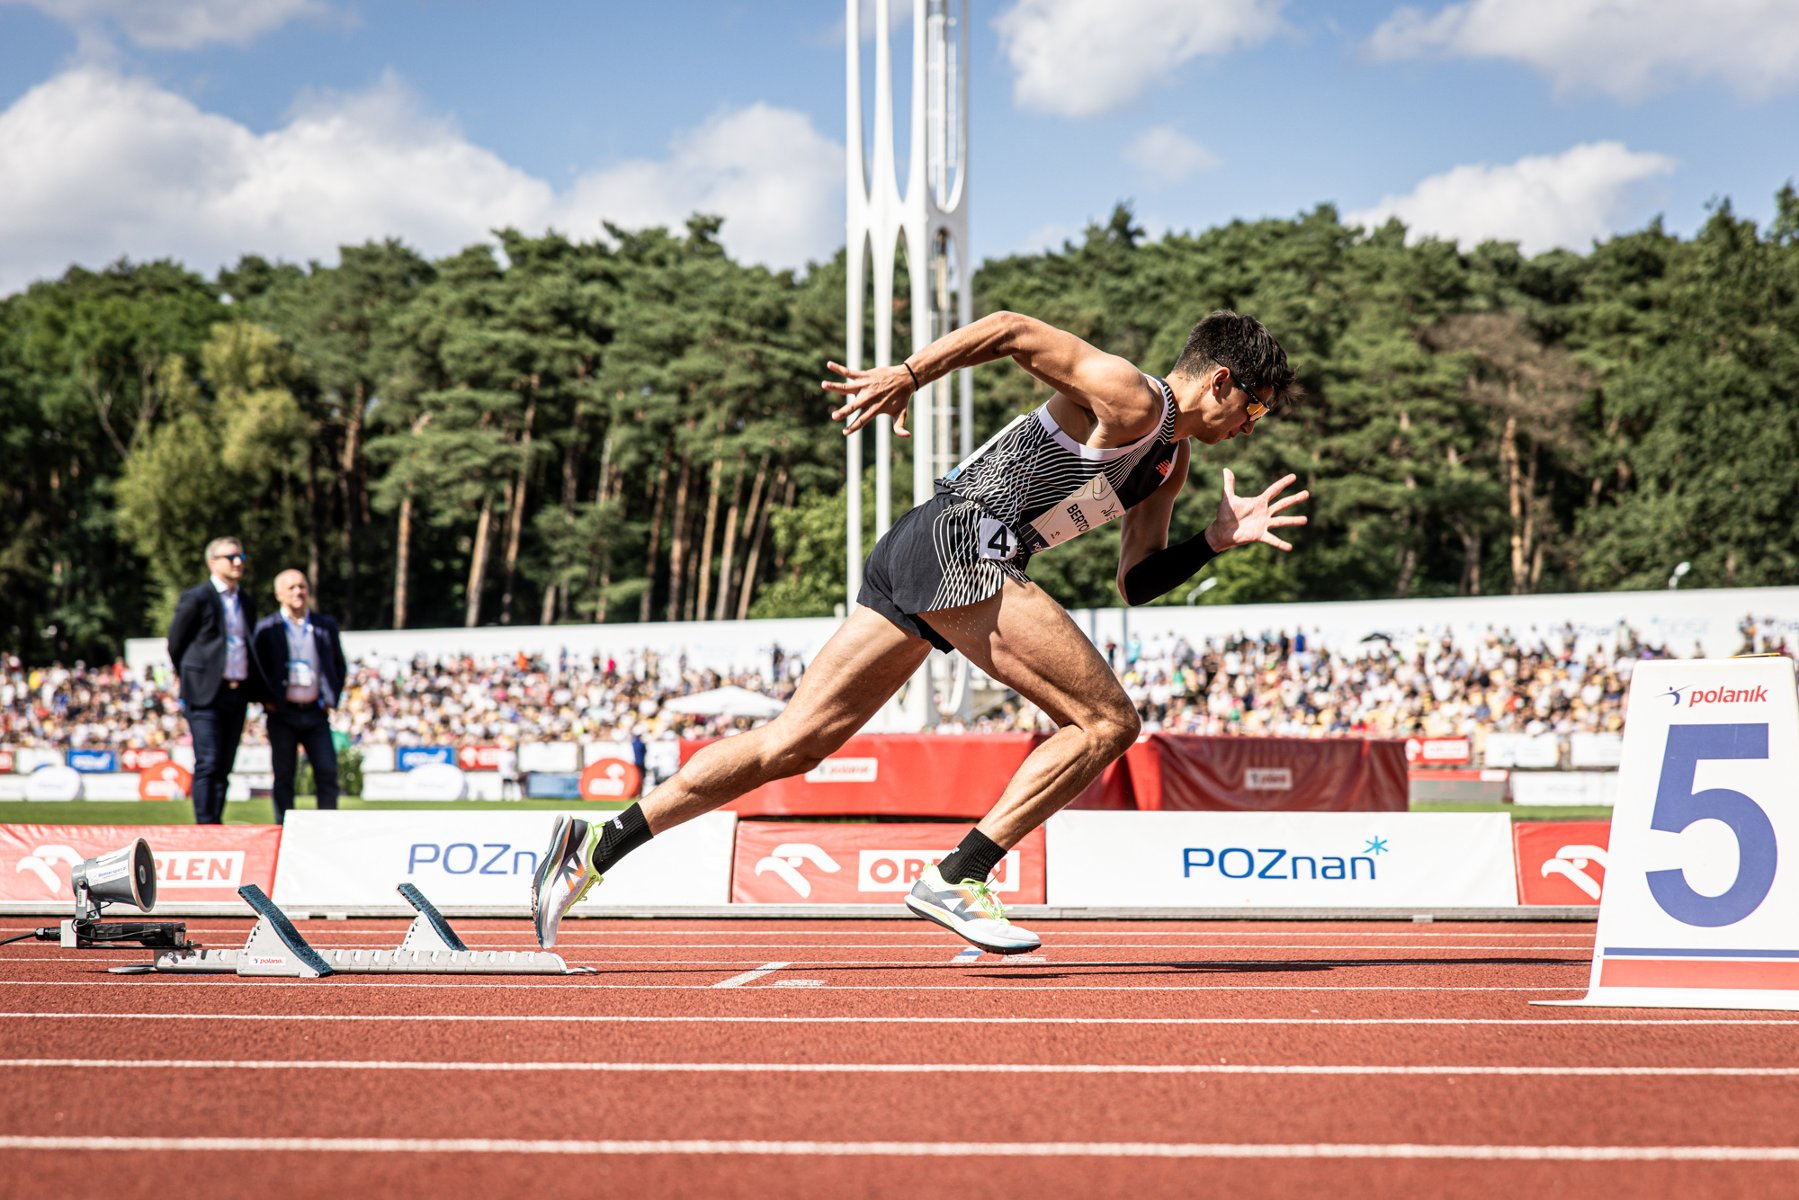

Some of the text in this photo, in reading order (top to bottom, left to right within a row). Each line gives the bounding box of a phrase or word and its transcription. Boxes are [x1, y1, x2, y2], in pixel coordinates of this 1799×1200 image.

[987, 524, 1011, 557] 4
[1688, 684, 1769, 708] polanik
[1645, 723, 1778, 928] 5
[407, 842, 538, 875] POZn
[869, 858, 1008, 884] ORN
